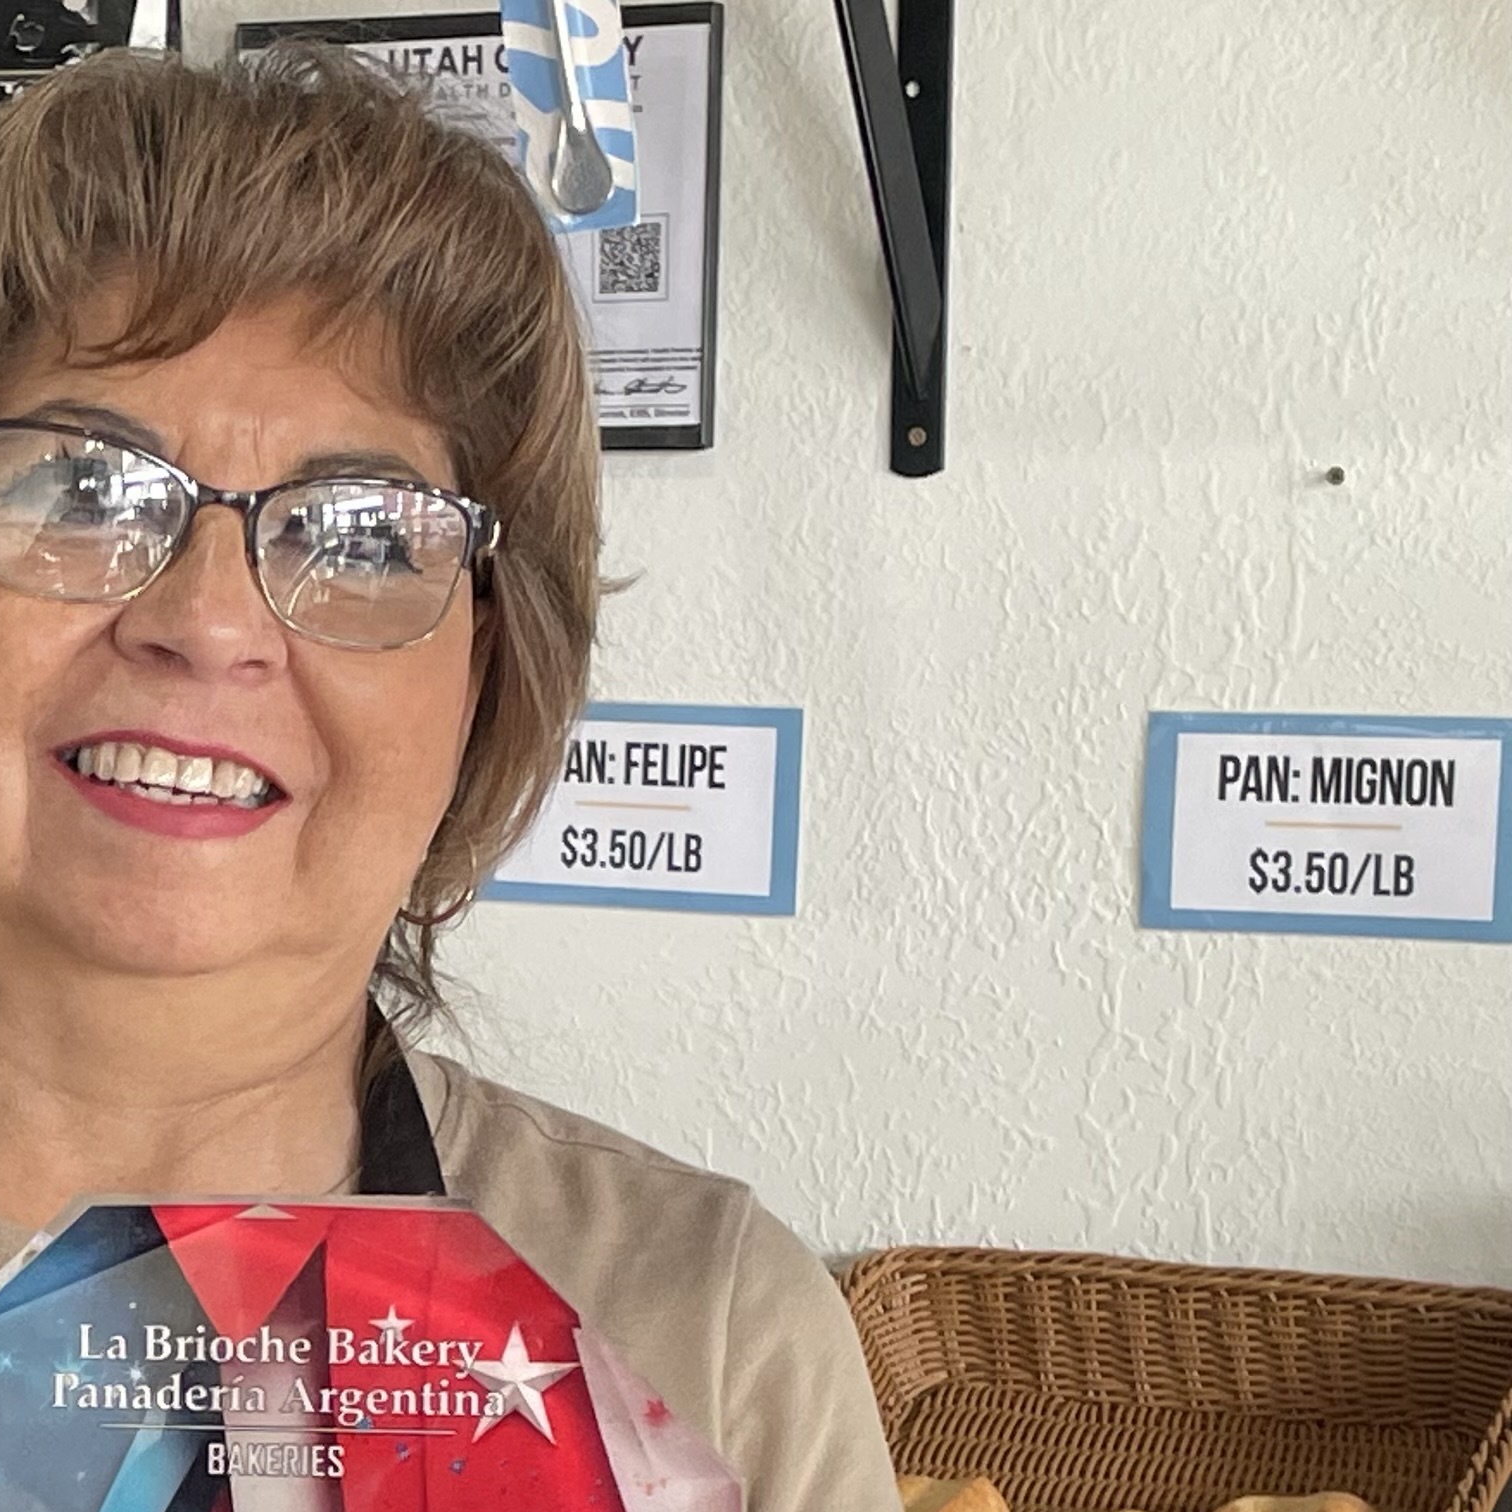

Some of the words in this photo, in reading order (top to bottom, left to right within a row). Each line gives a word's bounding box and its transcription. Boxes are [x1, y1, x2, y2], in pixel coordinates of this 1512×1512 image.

[389, 45, 483, 76] UTAH
[563, 739, 616, 785] AN:
[623, 742, 728, 790] FELIPE
[1218, 754, 1301, 804] PAN:
[1310, 756, 1456, 807] MIGNON
[560, 824, 703, 873] $3.50/LB
[1248, 847, 1415, 897] $3.50/LB
[78, 1324, 128, 1361] La
[144, 1325, 312, 1365] Brioche
[327, 1327, 484, 1379] Bakery
[52, 1372, 267, 1414] Panadería
[287, 1379, 506, 1426] Argentina
[207, 1442, 345, 1478] BAKERIES
